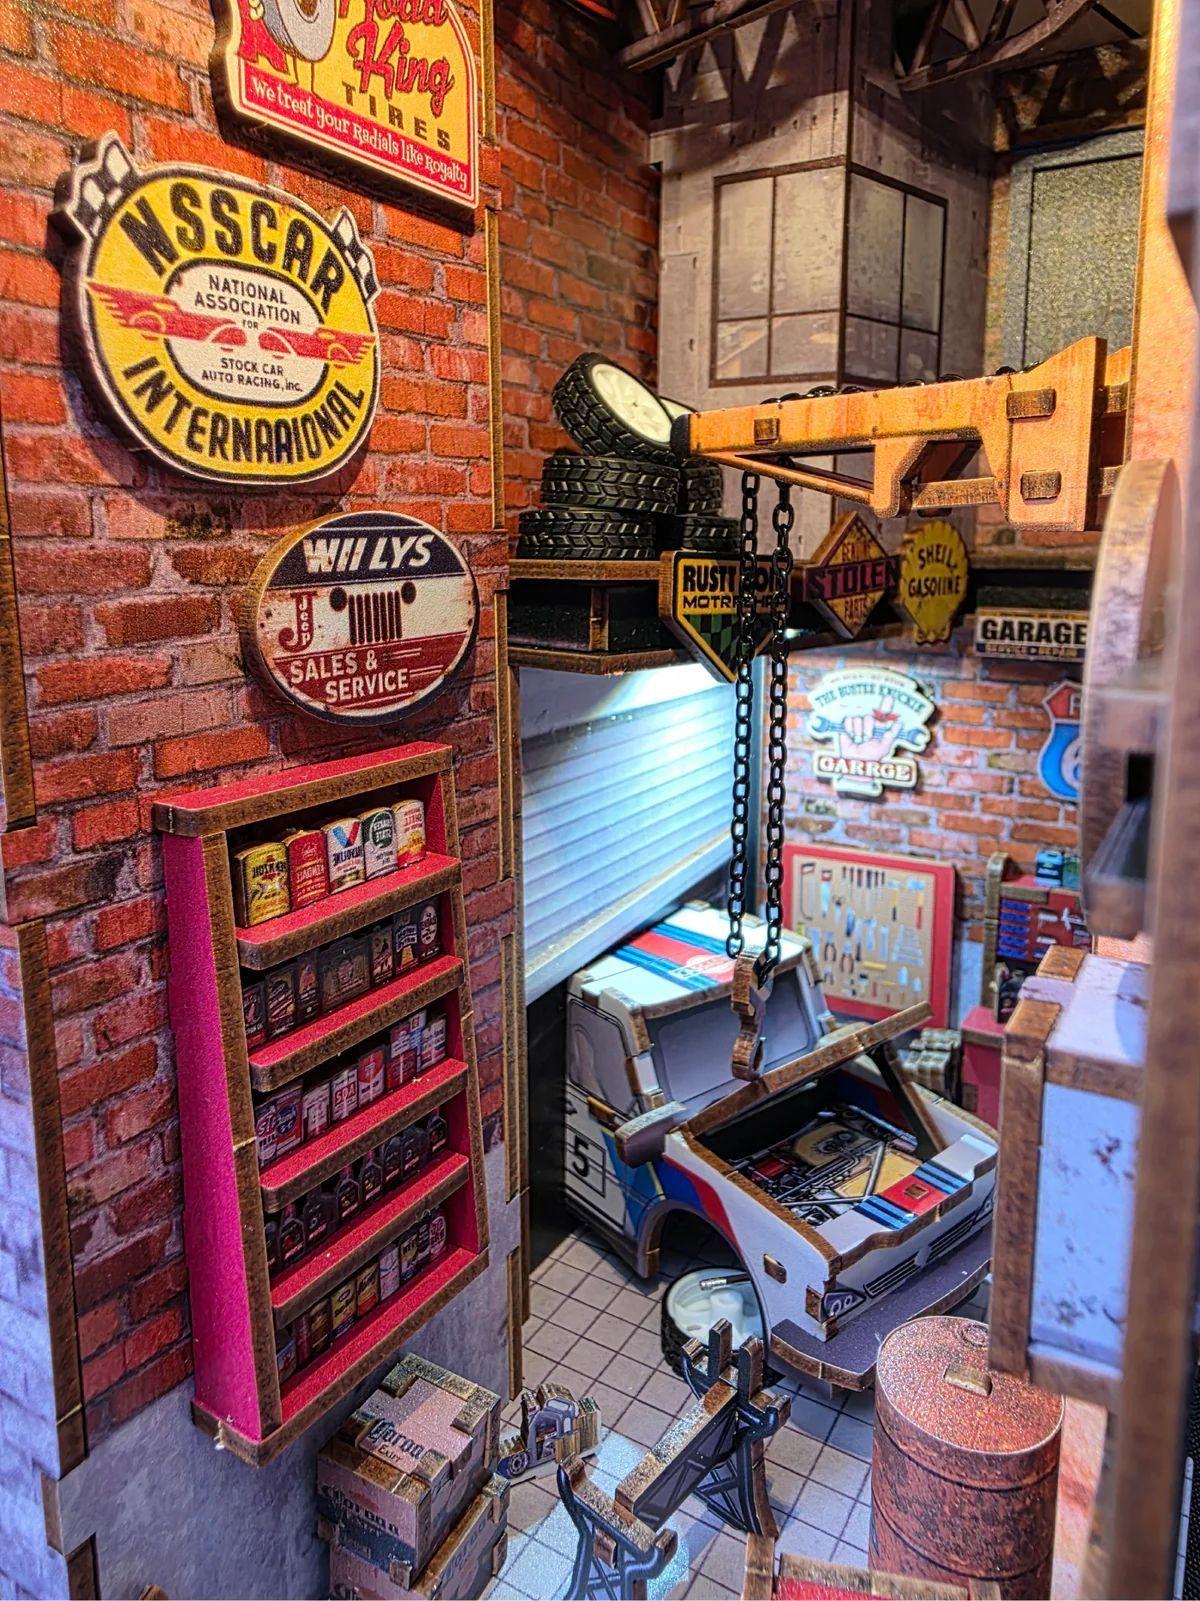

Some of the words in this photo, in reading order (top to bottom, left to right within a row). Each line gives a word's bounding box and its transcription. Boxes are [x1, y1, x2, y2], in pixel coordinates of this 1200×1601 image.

[346, 20, 455, 118] King
[252, 76, 275, 101] We
[277, 83, 314, 119] treat
[315, 104, 350, 133] your
[352, 122, 399, 156] Radials
[401, 139, 424, 165] like
[424, 153, 467, 190] Royalty
[342, 80, 451, 151] TIRES
[119, 182, 346, 316] NSSCAR
[208, 274, 288, 305] NATIONAL
[194, 291, 301, 325] ASSOCIATION
[242, 319, 259, 331] FOR
[202, 369, 234, 384] AUTO
[221, 357, 259, 374] STOCK
[262, 363, 284, 377] CAR
[809, 557, 900, 601] STOLEN
[981, 618, 1089, 646] GARAGE
[290, 652, 358, 684] SALES
[366, 649, 378, 671] &
[325, 667, 409, 703] SERVICE
